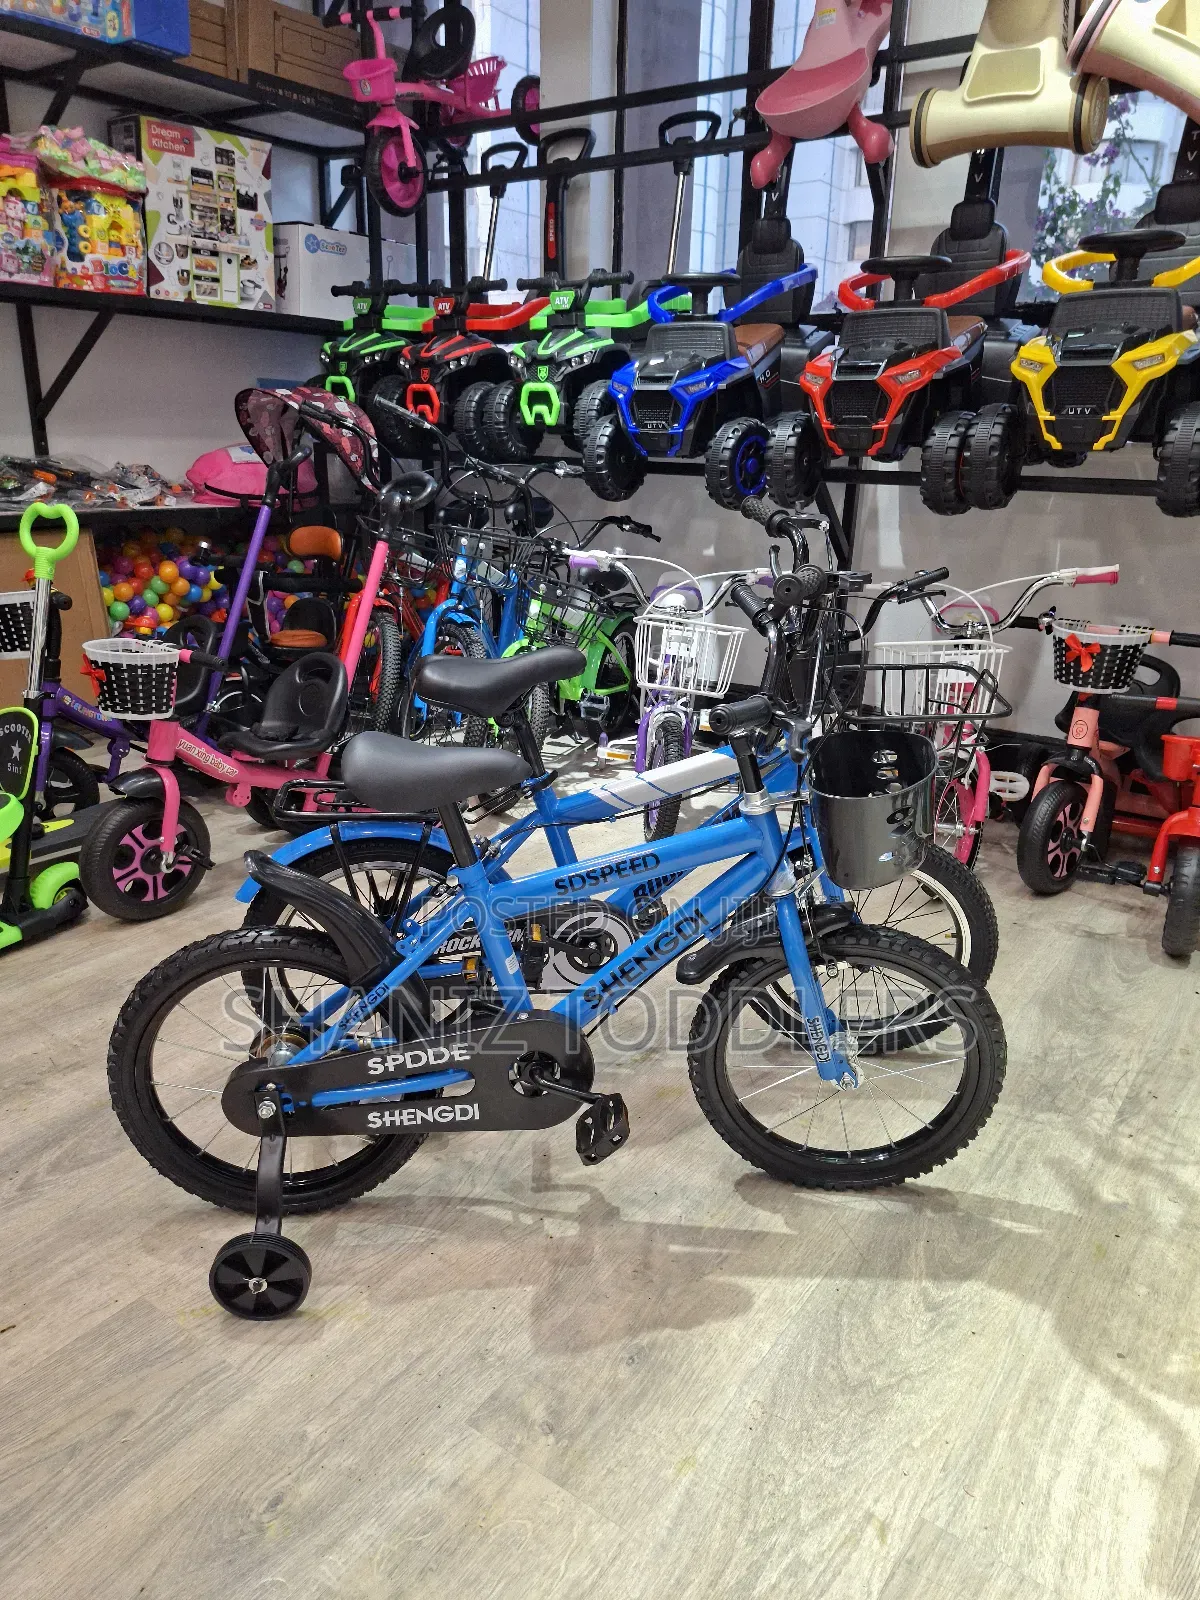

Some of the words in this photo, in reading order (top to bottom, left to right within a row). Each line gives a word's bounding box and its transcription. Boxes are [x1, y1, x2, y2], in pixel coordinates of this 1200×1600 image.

[151, 124, 181, 139] Dream
[152, 138, 186, 153] Kitchen
[356, 302, 368, 310] ATV
[438, 302, 450, 310] ATV
[555, 296, 570, 305] ATV
[1068, 407, 1091, 415] UTV
[176, 739, 197, 756] yuan
[195, 748, 211, 764] xing
[209, 754, 227, 773] baby
[225, 765, 239, 777] car
[554, 852, 661, 896] SDSPEED
[583, 907, 709, 1010] SHENGDI
[805, 1016, 832, 1063] SHENGDI
[367, 1042, 471, 1075] SPDDE
[367, 1102, 480, 1129] SHENGDI
